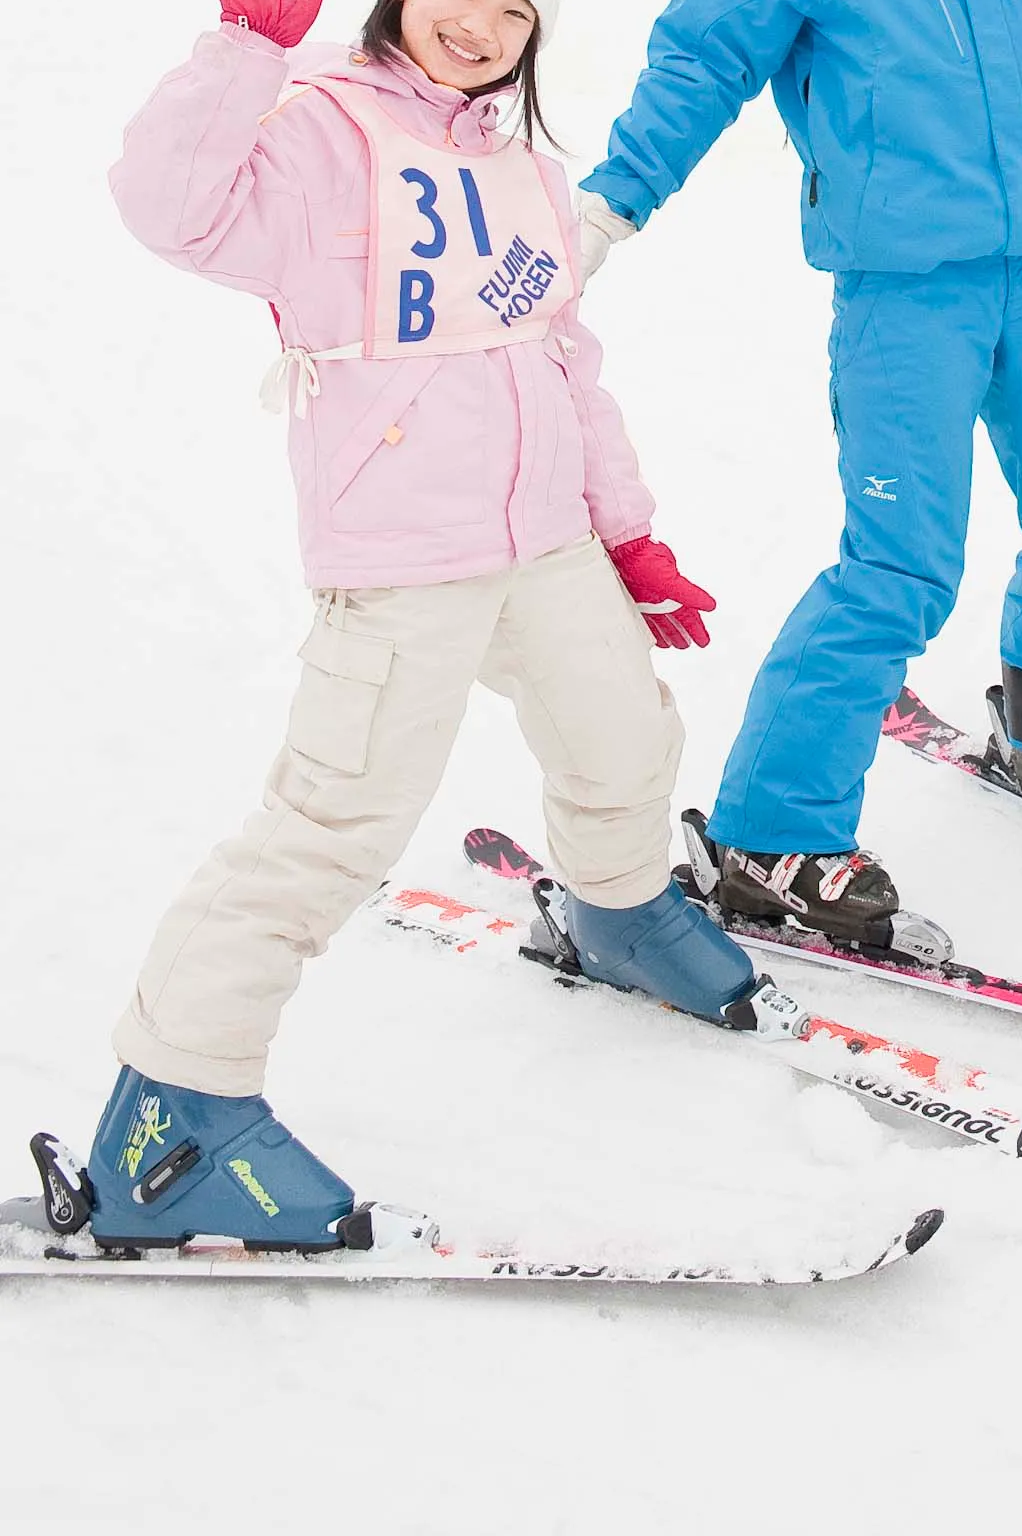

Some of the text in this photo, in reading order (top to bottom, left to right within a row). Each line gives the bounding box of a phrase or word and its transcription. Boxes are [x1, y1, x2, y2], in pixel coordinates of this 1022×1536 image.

[399, 167, 493, 259] 31
[398, 269, 435, 343] B
[477, 234, 534, 312] FUJIMI
[500, 250, 560, 328] KOGEN
[833, 1073, 1006, 1144] OSSIGNOL
